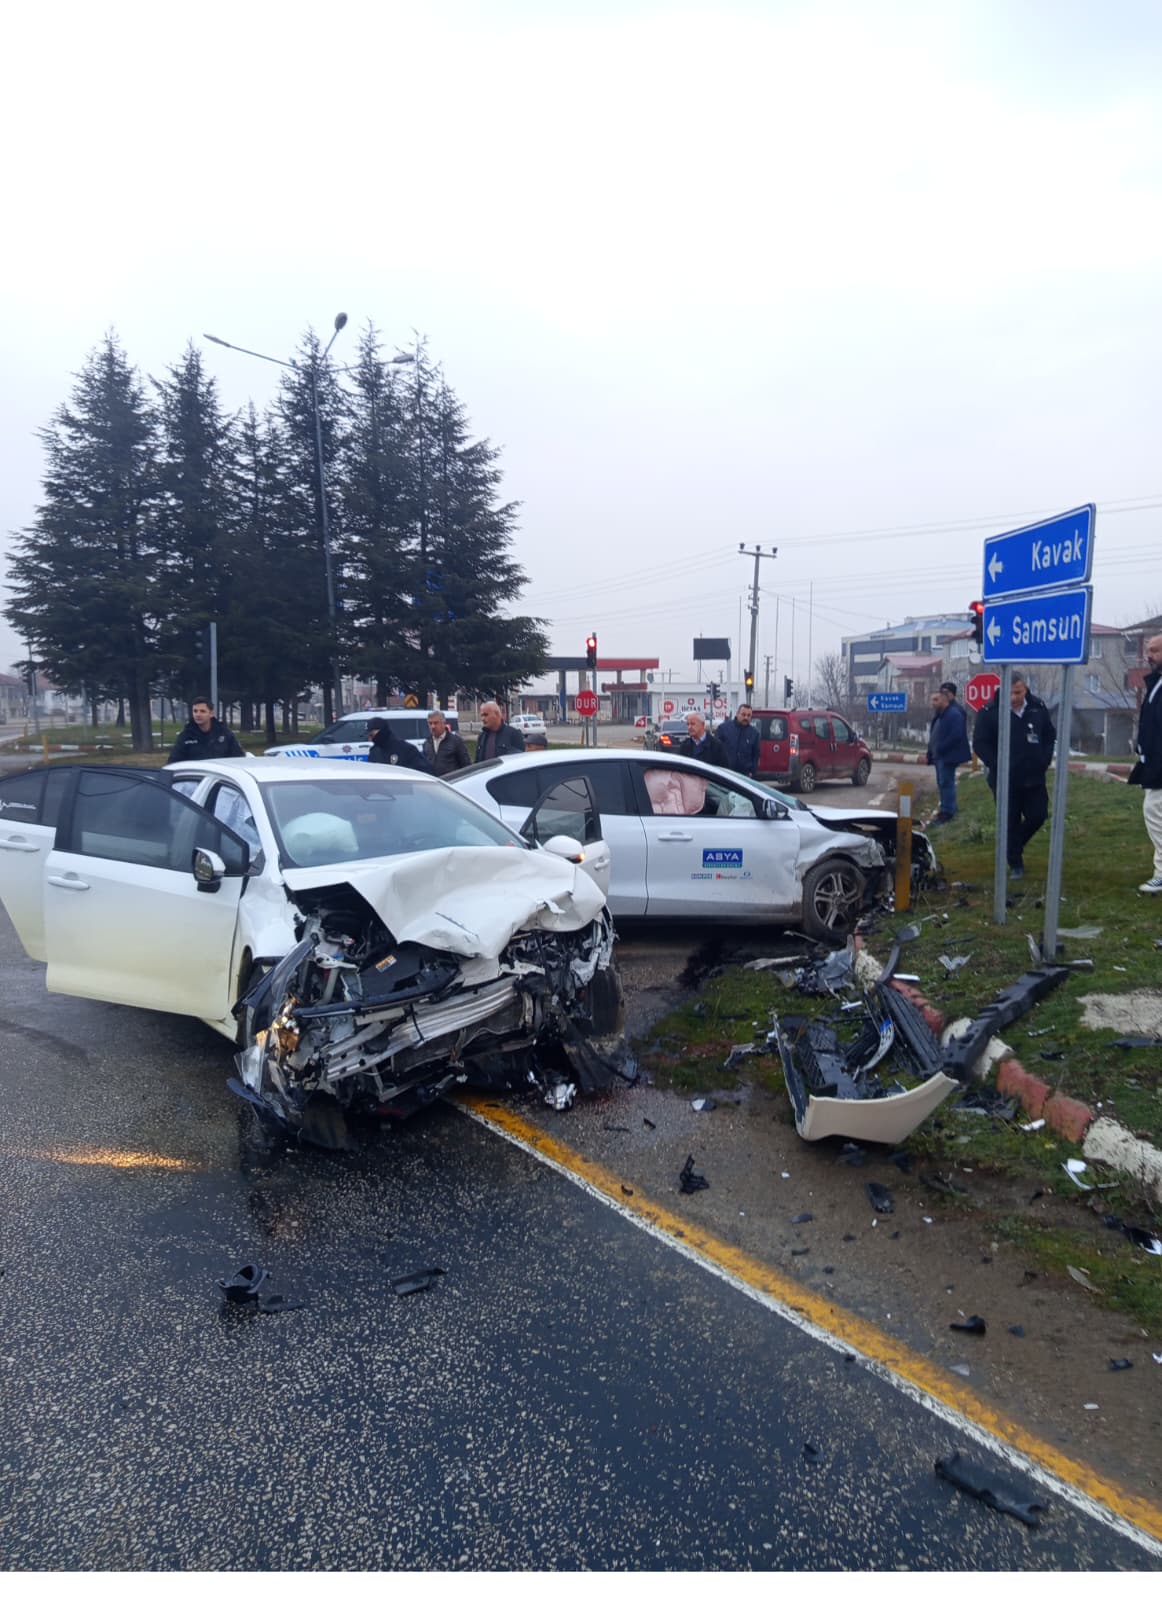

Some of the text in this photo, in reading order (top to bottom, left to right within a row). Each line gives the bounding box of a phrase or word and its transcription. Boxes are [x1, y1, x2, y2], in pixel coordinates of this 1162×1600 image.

[1031, 529, 1084, 572] Kavak
[1012, 613, 1081, 645] Samsun
[968, 685, 1000, 701] DU
[576, 695, 597, 709] DUR
[706, 852, 739, 861] ABYA
